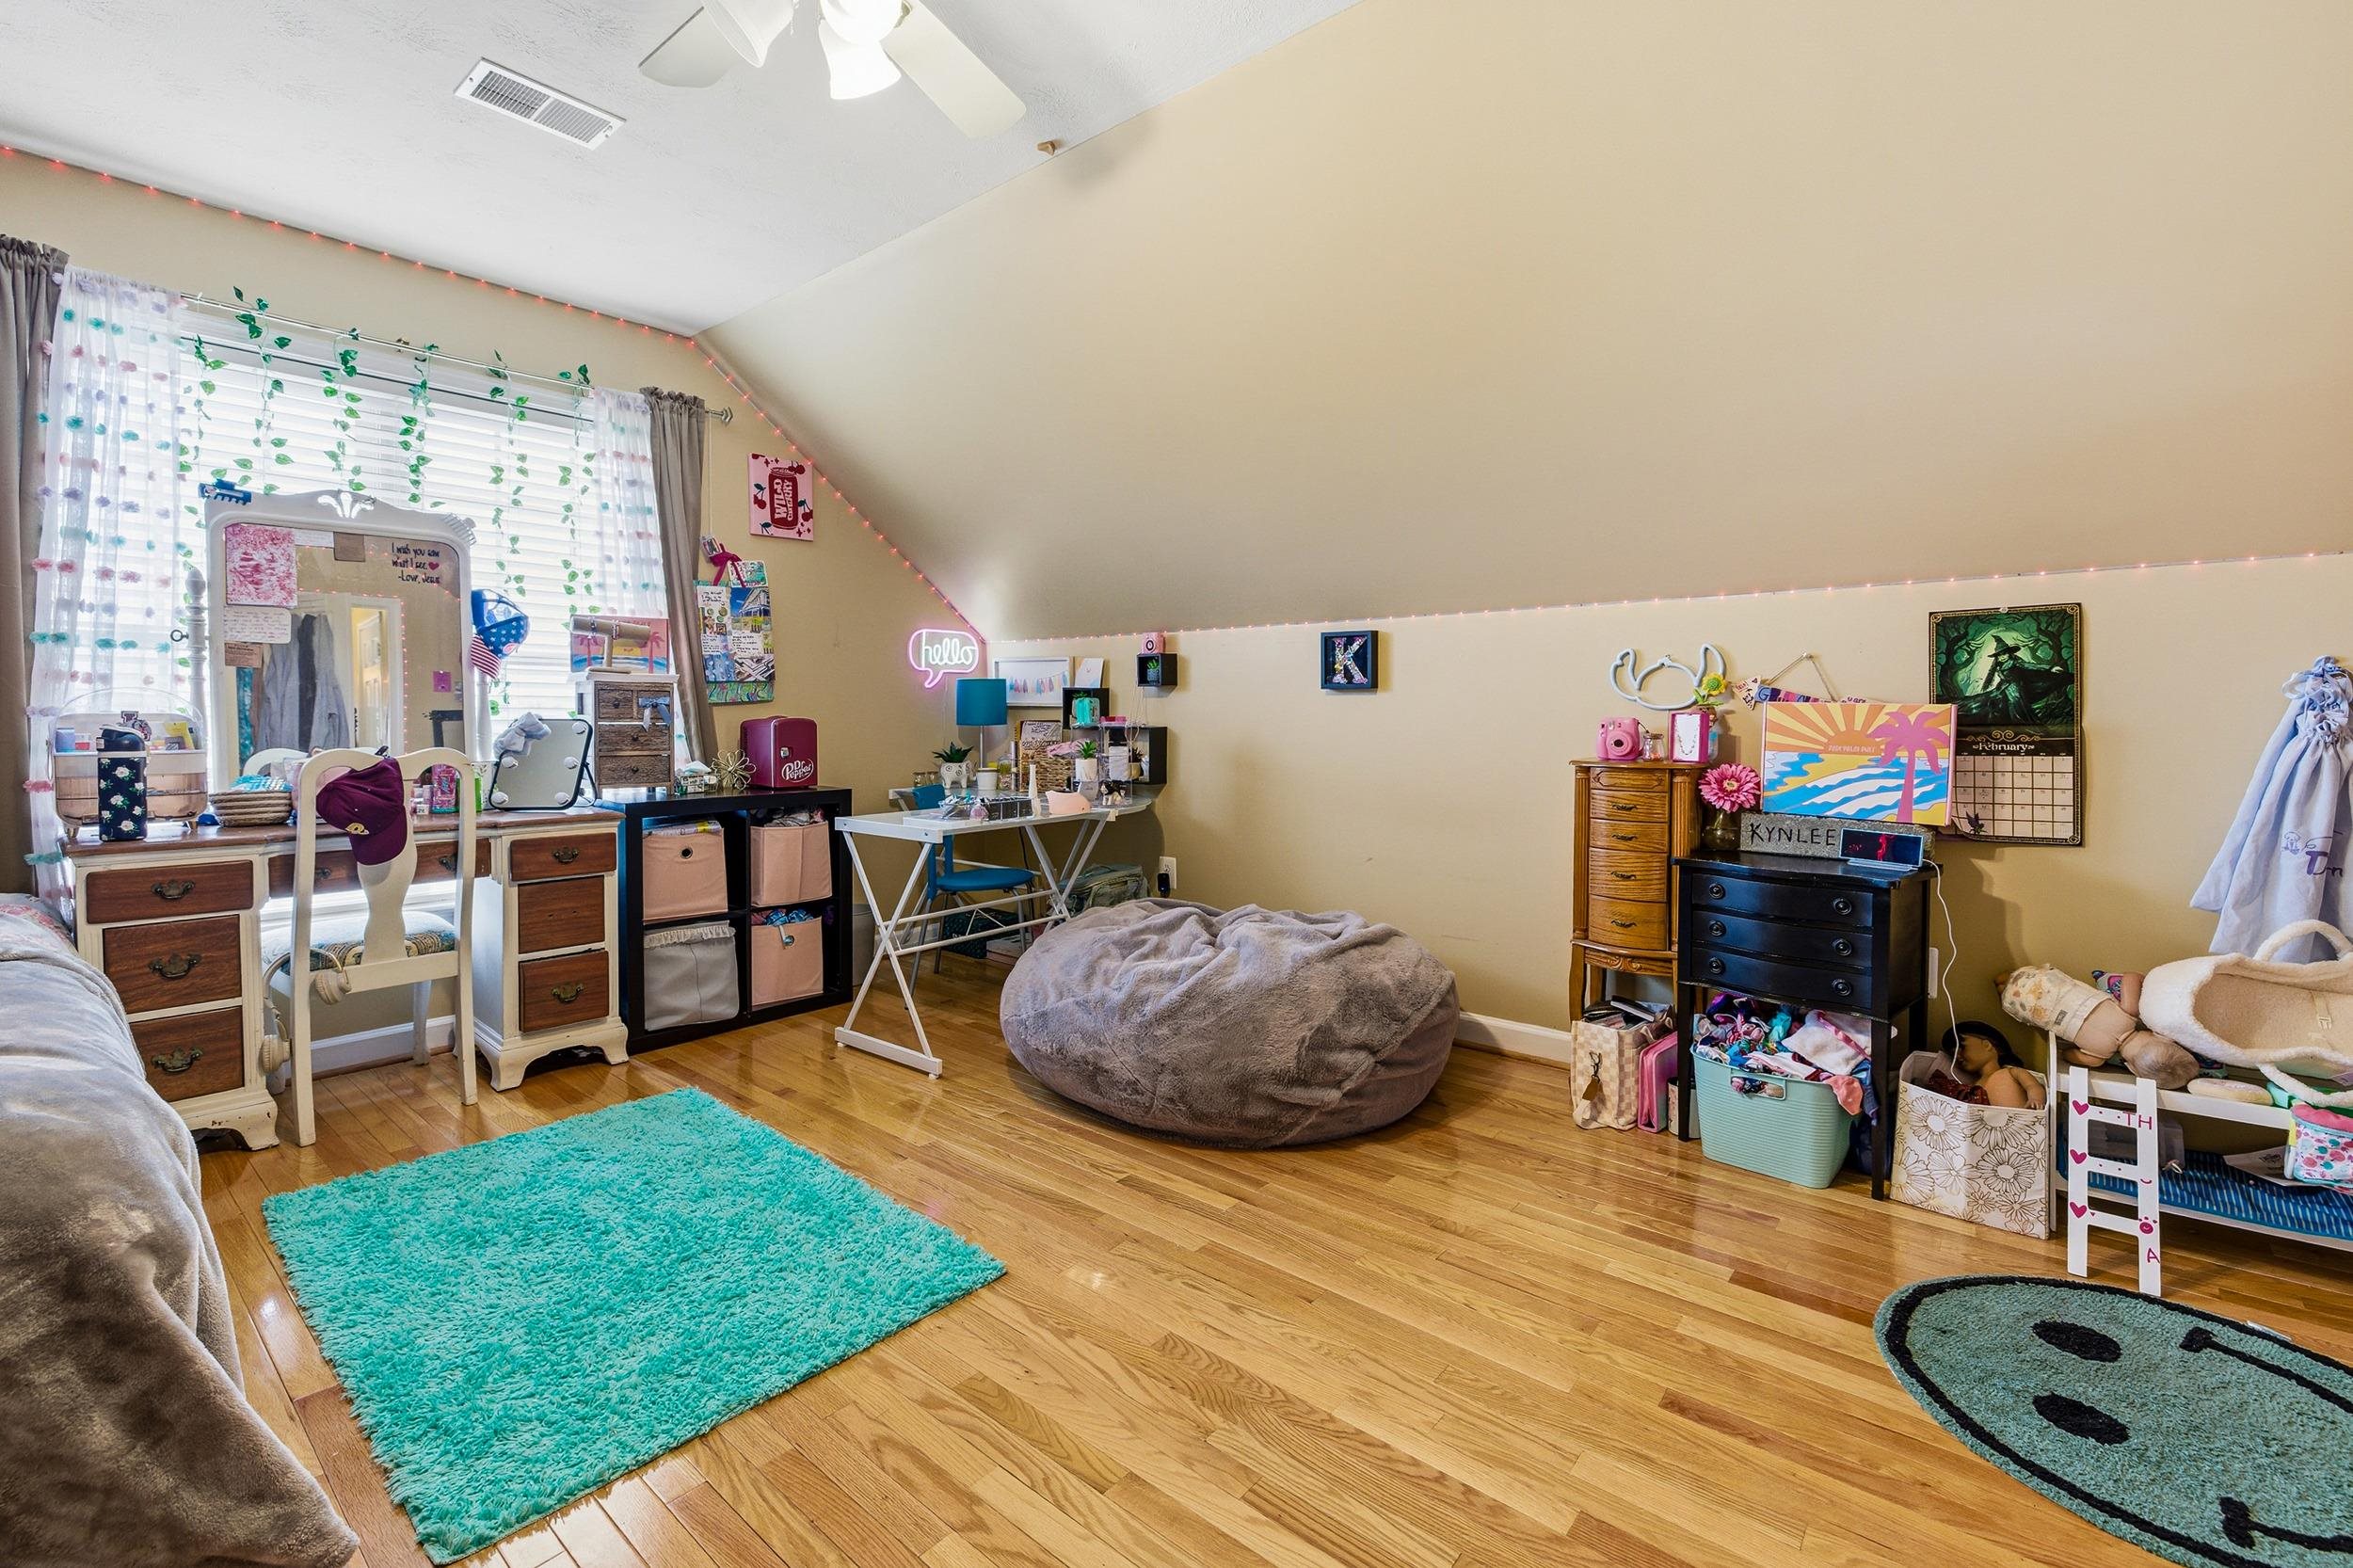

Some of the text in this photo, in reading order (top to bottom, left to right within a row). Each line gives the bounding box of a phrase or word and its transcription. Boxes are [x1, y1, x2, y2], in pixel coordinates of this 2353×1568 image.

[774, 478, 789, 519] WILD
[783, 479, 793, 521] CHERRY
[413, 548, 425, 558] you
[921, 632, 977, 668] hello
[1332, 635, 1369, 685] K
[1978, 742, 2028, 752] February
[785, 762, 812, 780] Pepper
[1749, 823, 1836, 846] KYNLEE
